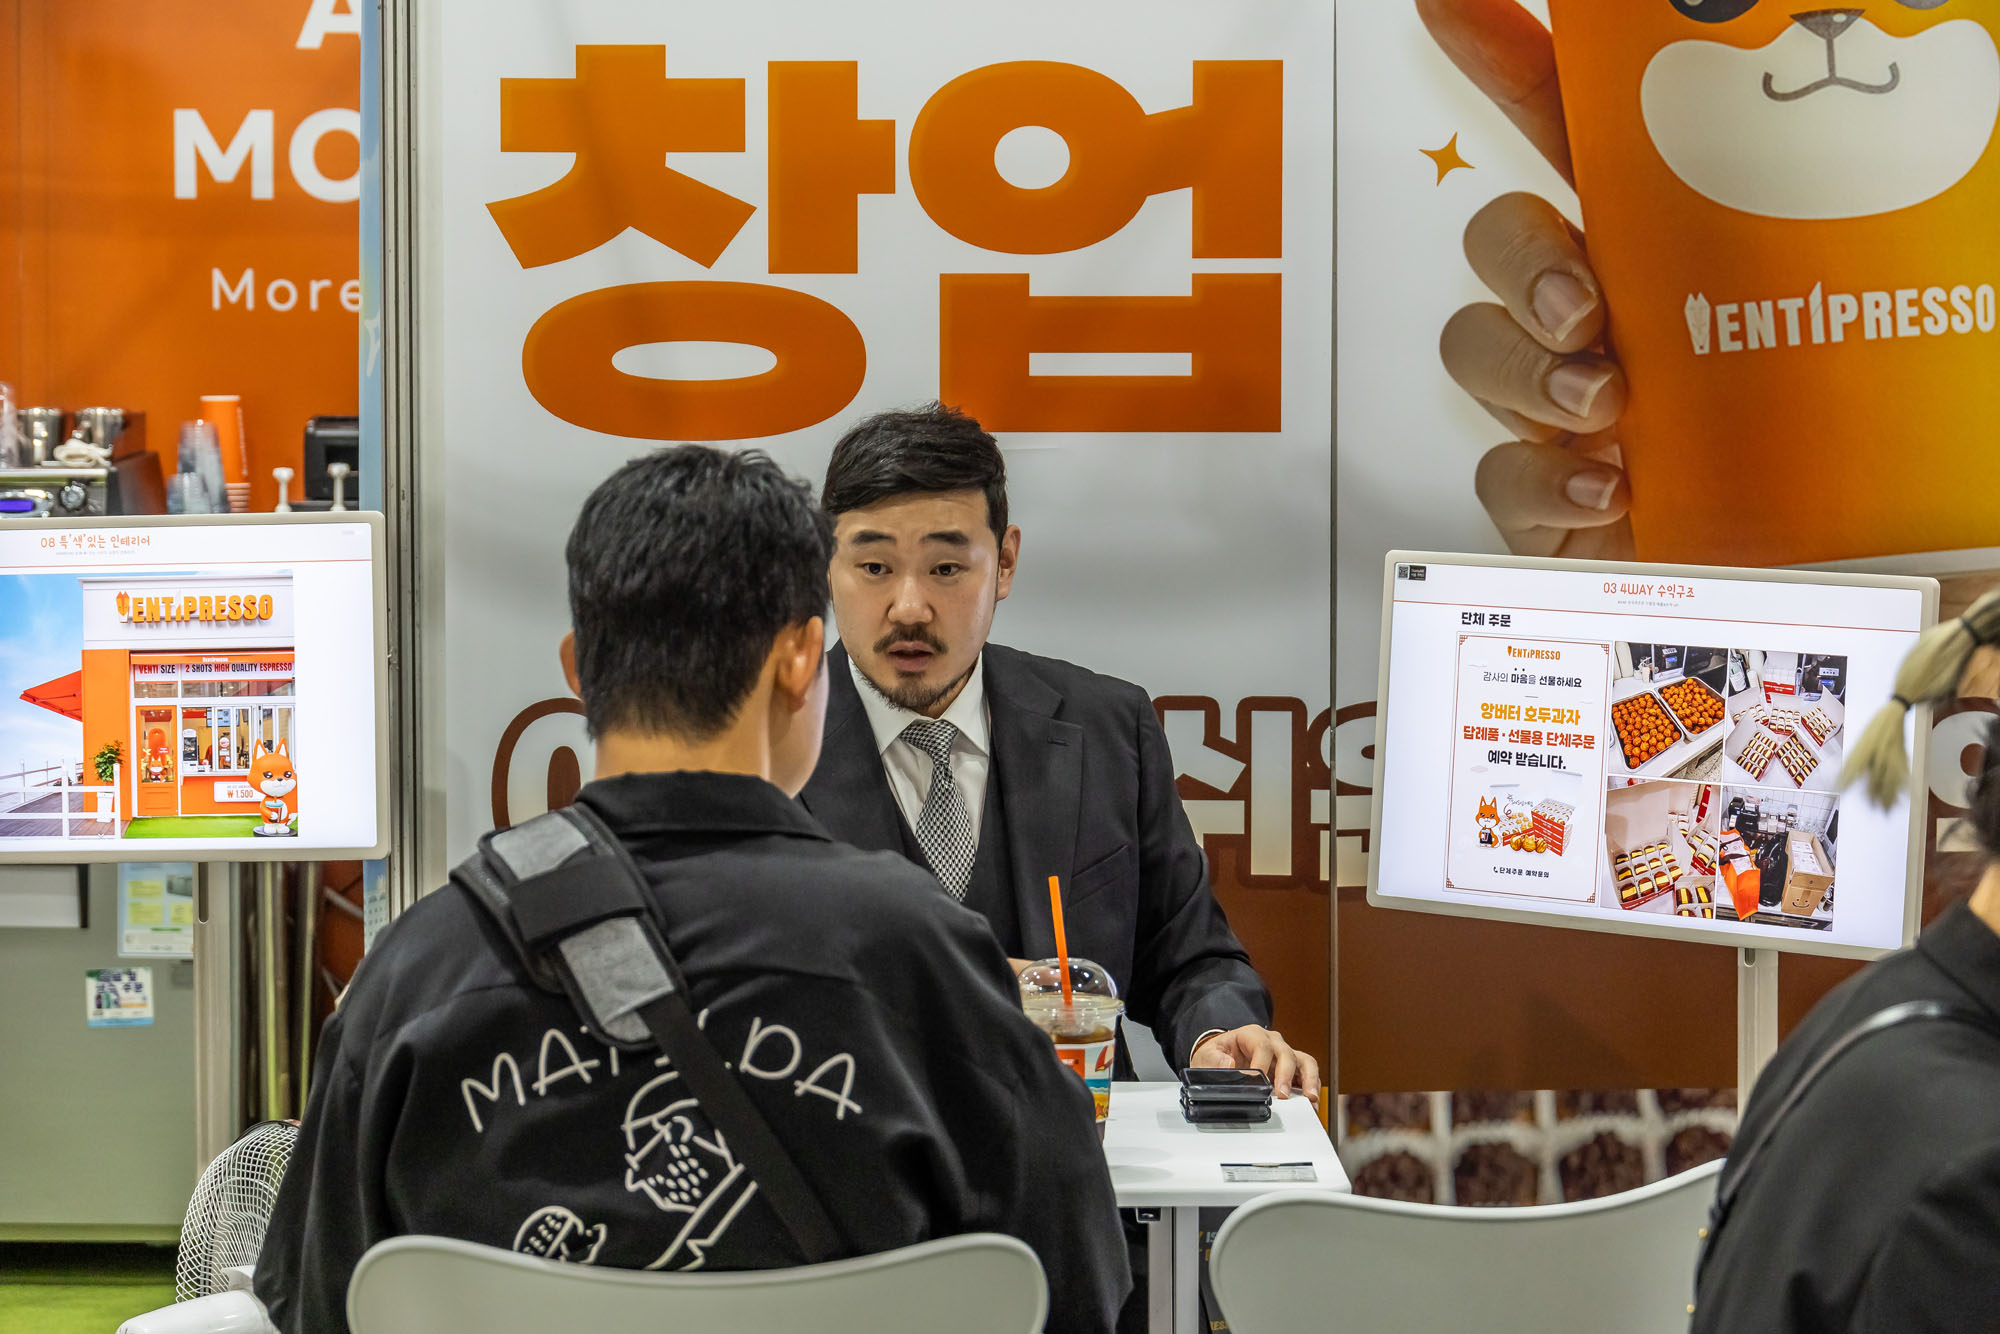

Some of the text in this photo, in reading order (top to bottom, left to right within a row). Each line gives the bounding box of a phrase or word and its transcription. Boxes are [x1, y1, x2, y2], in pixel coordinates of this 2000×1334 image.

[173, 107, 361, 203] MO
[485, 44, 1284, 441] 창업
[211, 267, 363, 313] More
[40, 537, 56, 549] 08
[110, 534, 151, 549] 인테리어
[1603, 582, 1695, 599] 03 4WAY 수익구조
[1461, 612, 1511, 628] 단체 주문
[138, 664, 176, 674] VENTI SIZE
[185, 662, 293, 673] 2 SHOTS HIGH QUALITY ESPRESSO
[1483, 671, 1582, 688] 감사의 마음을 선물하세요
[1480, 702, 1581, 726] 앙버터 호두과자
[1463, 725, 1596, 749] 답례품 선물용 단체주문
[1487, 750, 1567, 770] 예약 받습니다.
[460, 1008, 863, 1134] MADA
